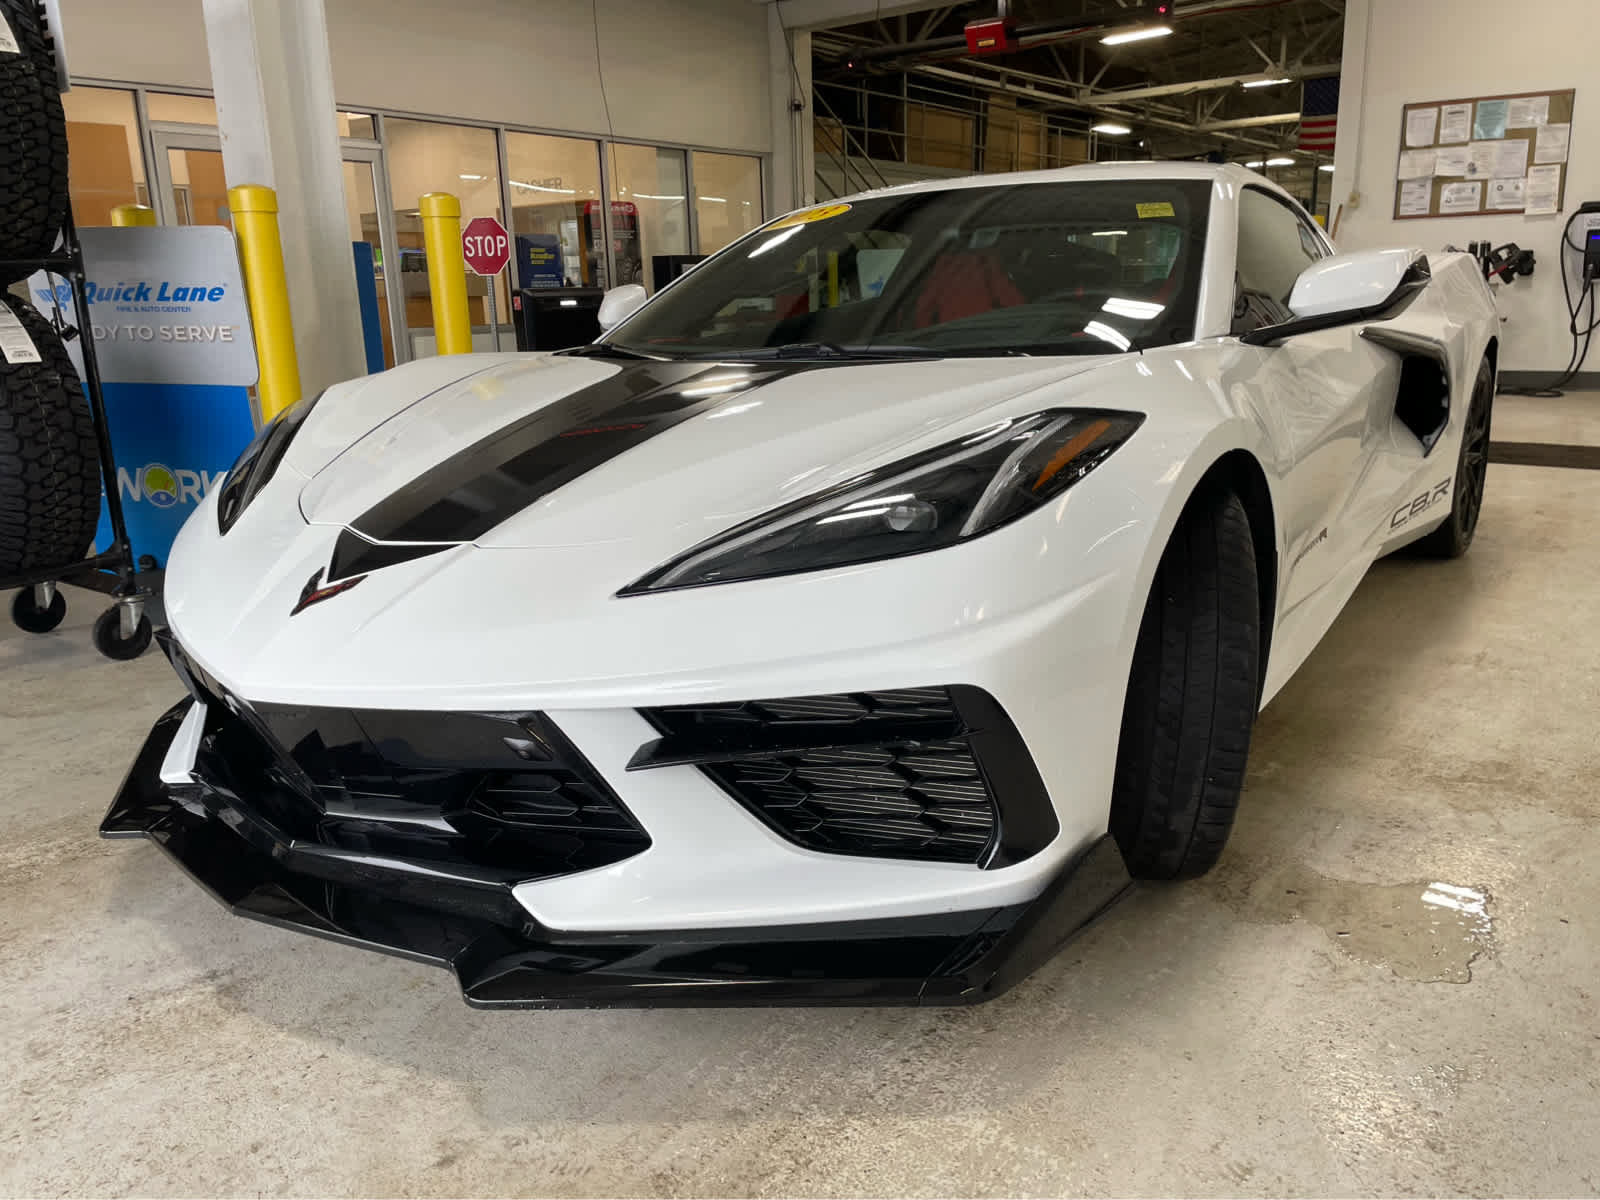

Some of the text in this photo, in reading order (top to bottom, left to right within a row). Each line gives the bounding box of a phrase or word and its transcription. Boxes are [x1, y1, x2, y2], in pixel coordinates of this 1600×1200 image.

[464, 235, 507, 257] STOP
[84, 281, 225, 304] Quick Lane
[123, 325, 153, 341] TO
[159, 324, 233, 342] SERVE
